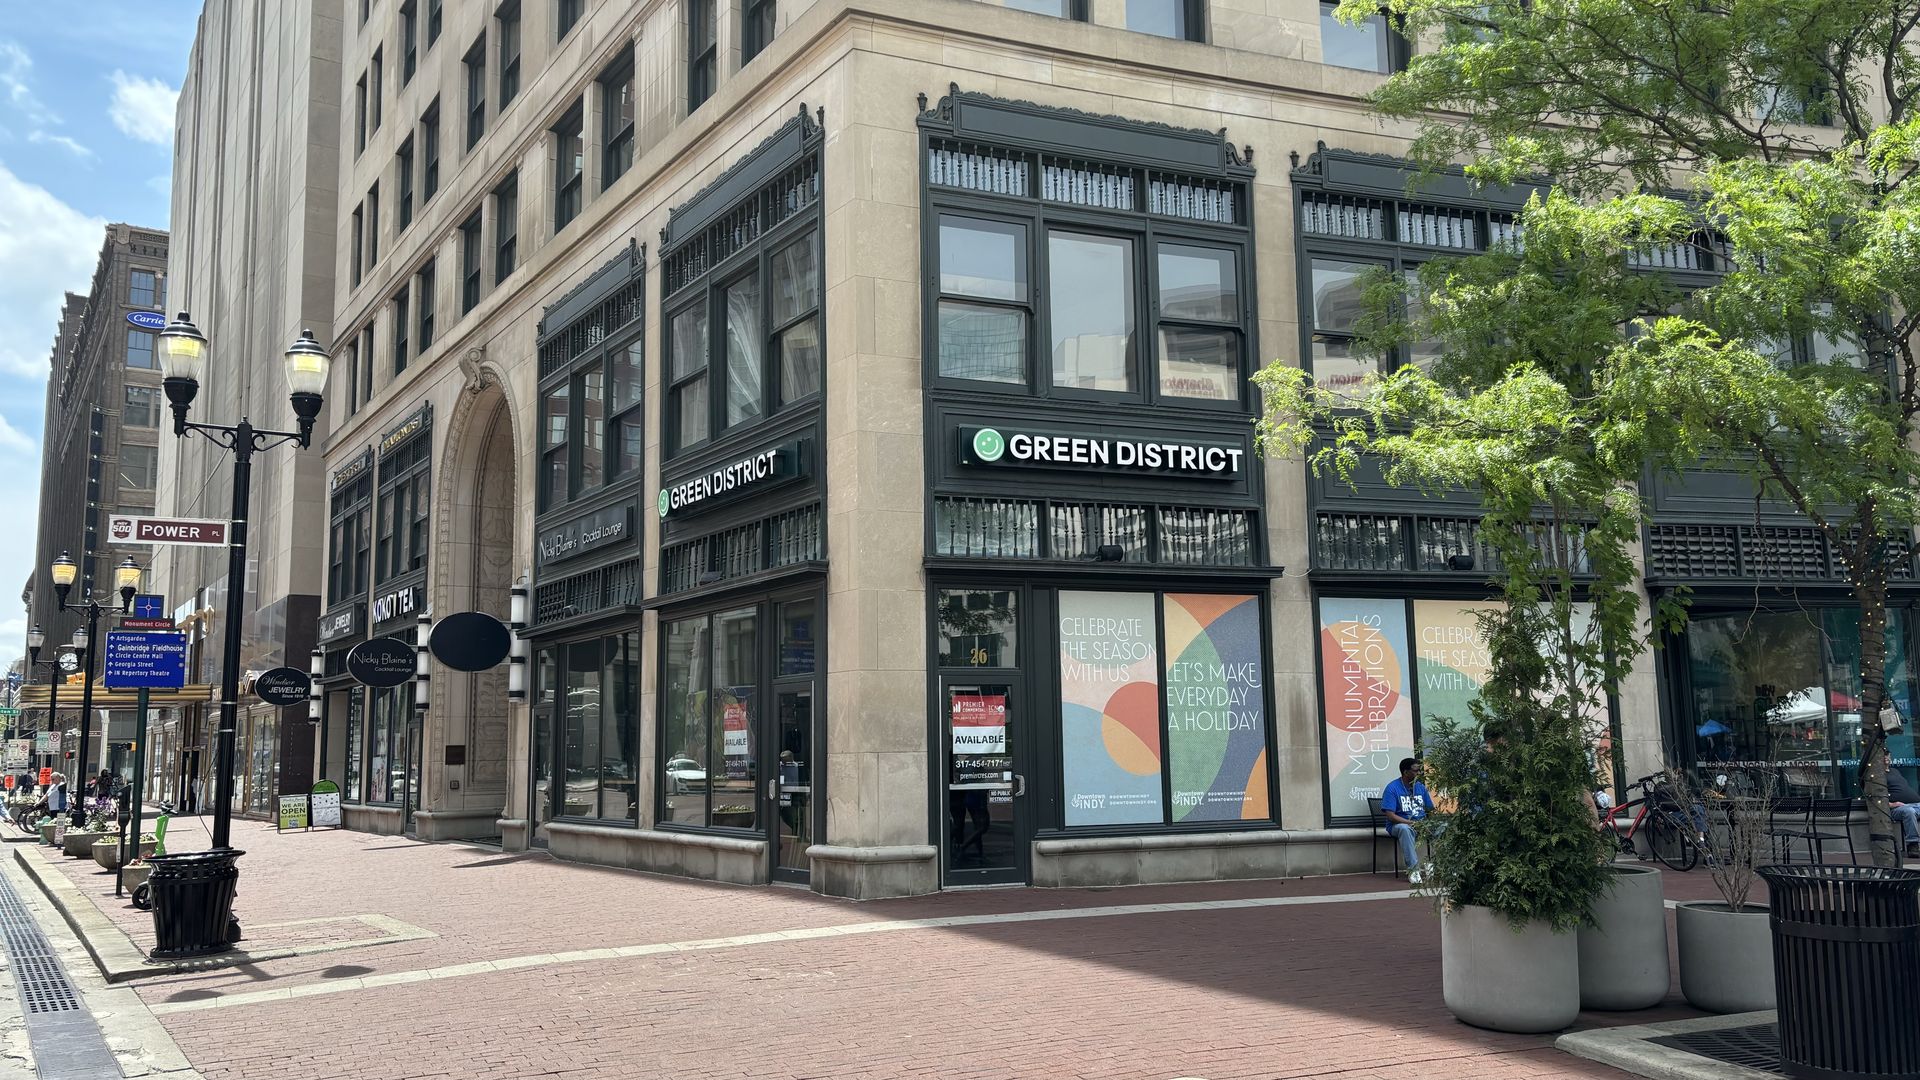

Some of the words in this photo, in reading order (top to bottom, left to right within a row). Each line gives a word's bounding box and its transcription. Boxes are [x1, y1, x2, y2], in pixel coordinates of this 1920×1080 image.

[1010, 434, 1109, 464] GREEN
[1116, 441, 1243, 472] DISTRICT
[670, 474, 712, 510] GREEN
[713, 450, 777, 495] DISTRICT
[112, 525, 132, 534] 500
[142, 524, 200, 538] POWER
[582, 527, 602, 544] Cocktail
[602, 522, 622, 537] Lounge
[398, 587, 414, 615] TEA
[1061, 617, 1142, 641] CELEBRATE
[1422, 626, 1485, 649] CELEBRA
[353, 652, 379, 665] Nicky
[382, 652, 413, 664] Blaine's
[970, 648, 988, 664] 26
[1061, 641, 1087, 660] THE
[1092, 642, 1157, 660] SEASON
[1424, 649, 1448, 667] THE
[1452, 650, 1493, 667] SEAS
[262, 674, 295, 686] Windsor
[1061, 664, 1104, 682] WITH
[1108, 664, 1130, 682] US
[1166, 663, 1204, 682] LET'S
[1209, 663, 1262, 688] MAKE
[1424, 673, 1463, 690] WITH
[1467, 673, 1485, 690] US
[1167, 686, 1249, 706] EVERYDAY
[1340, 614, 1367, 774] MONUMENTAL
[1363, 614, 1391, 771] CELEBRATIONS
[1168, 712, 1180, 731] A
[1186, 711, 1259, 731] HOLIDAY
[725, 738, 747, 746] AVAILABLE
[954, 735, 1004, 744] AVAILABLE
[955, 759, 1003, 768] 317-454-7171
[1080, 799, 1105, 809] INDY
[1180, 796, 1204, 805] INDY
[1357, 791, 1380, 800] INDY
